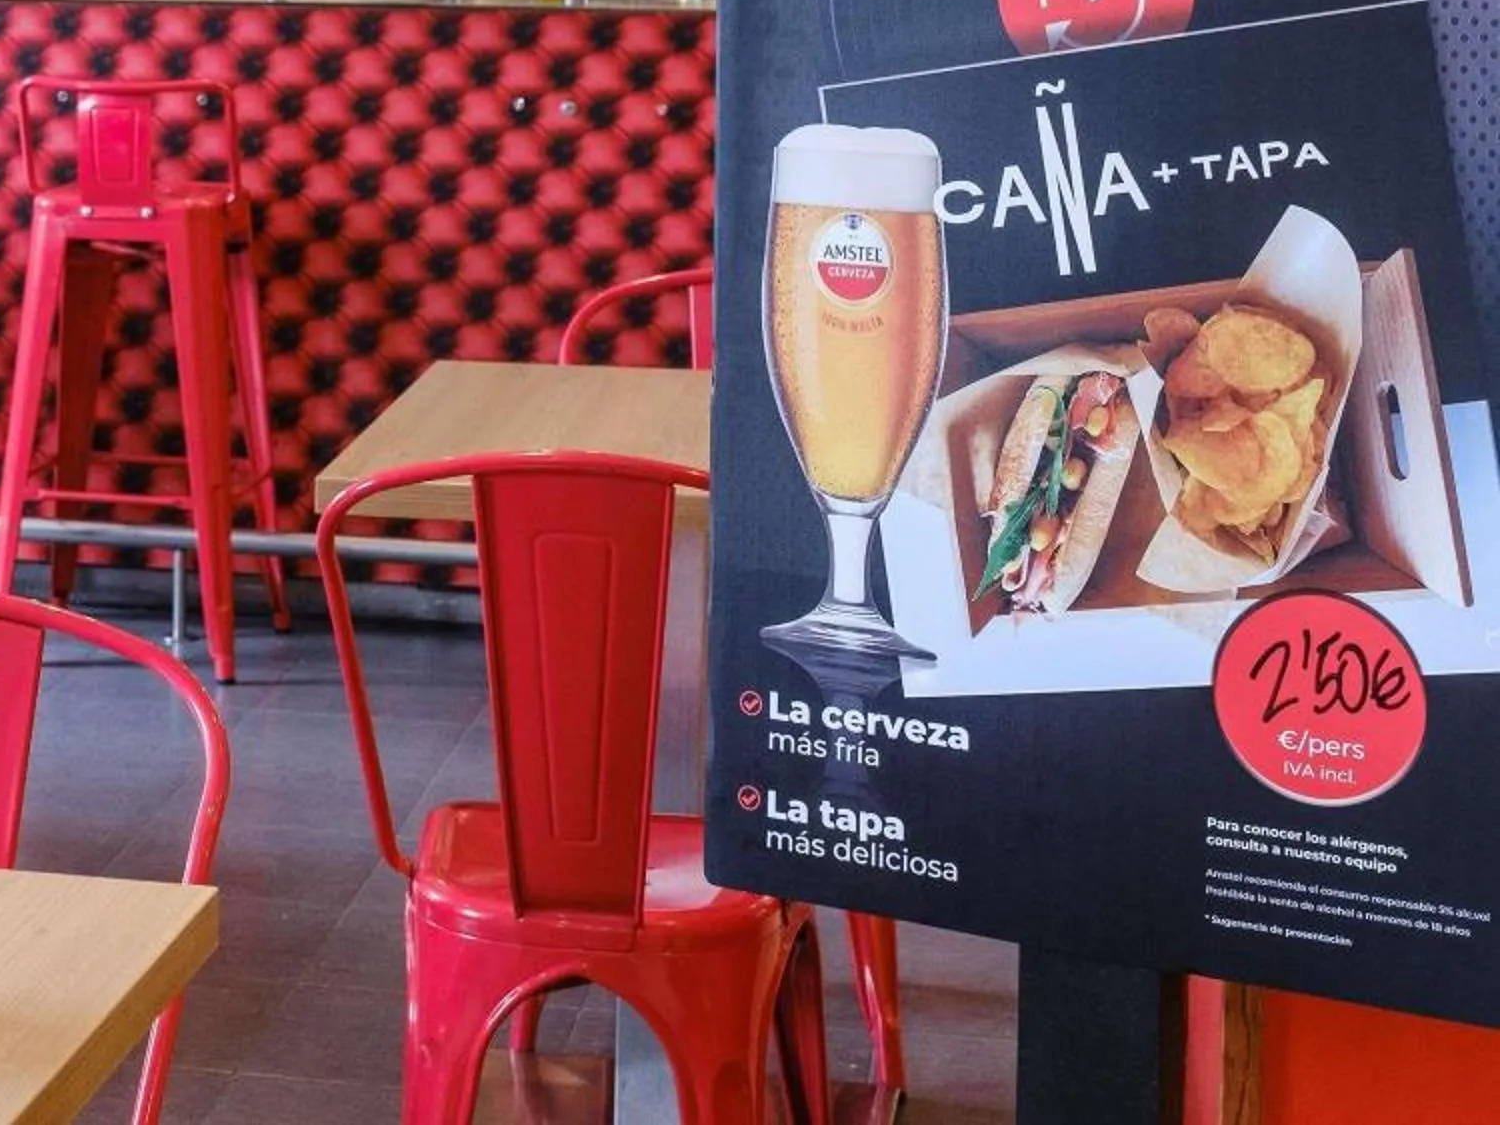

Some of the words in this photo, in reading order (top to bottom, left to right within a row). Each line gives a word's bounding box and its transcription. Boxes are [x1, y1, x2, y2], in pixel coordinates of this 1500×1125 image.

[933, 78, 1150, 276] CAÑA
[1190, 140, 1330, 183] TAPA
[823, 244, 882, 263] AMSTEL
[827, 266, 877, 280] CERVEZA
[769, 691, 810, 725] La
[822, 705, 970, 752] cerveza
[768, 731, 827, 758] más
[834, 736, 880, 767] fría
[1278, 730, 1366, 761] €/pers
[1284, 762, 1314, 778] IVA
[1320, 763, 1357, 784] incl.
[767, 790, 809, 824] La
[820, 800, 905, 841] tapa
[766, 830, 825, 857] más
[833, 837, 959, 881] deliciosa
[1206, 816, 1240, 833] Para
[1243, 821, 1302, 843] conocer
[1305, 830, 1327, 846] los
[1329, 834, 1409, 860] alérgenos,
[1206, 835, 1269, 855] consulta
[1271, 844, 1281, 856] a
[1284, 847, 1341, 865] nuestro
[1344, 856, 1398, 875] equipo
[1244, 873, 1306, 893] recomienda
[1308, 883, 1318, 894] el
[1319, 887, 1370, 903] consumo
[1371, 895, 1437, 915] responsable
[1211, 914, 1269, 935] Sugerencia
[1270, 924, 1283, 936] de
[1285, 927, 1353, 947] presentación
[1258, 893, 1268, 903] la
[1269, 896, 1298, 909] venta
[1301, 899, 1314, 912] de
[1316, 902, 1355, 920] alcohol
[1357, 910, 1364, 920] a
[1365, 912, 1412, 928] menores
[1414, 918, 1429, 931] de
[1431, 921, 1442, 933] 18
[1444, 924, 1472, 938] años
